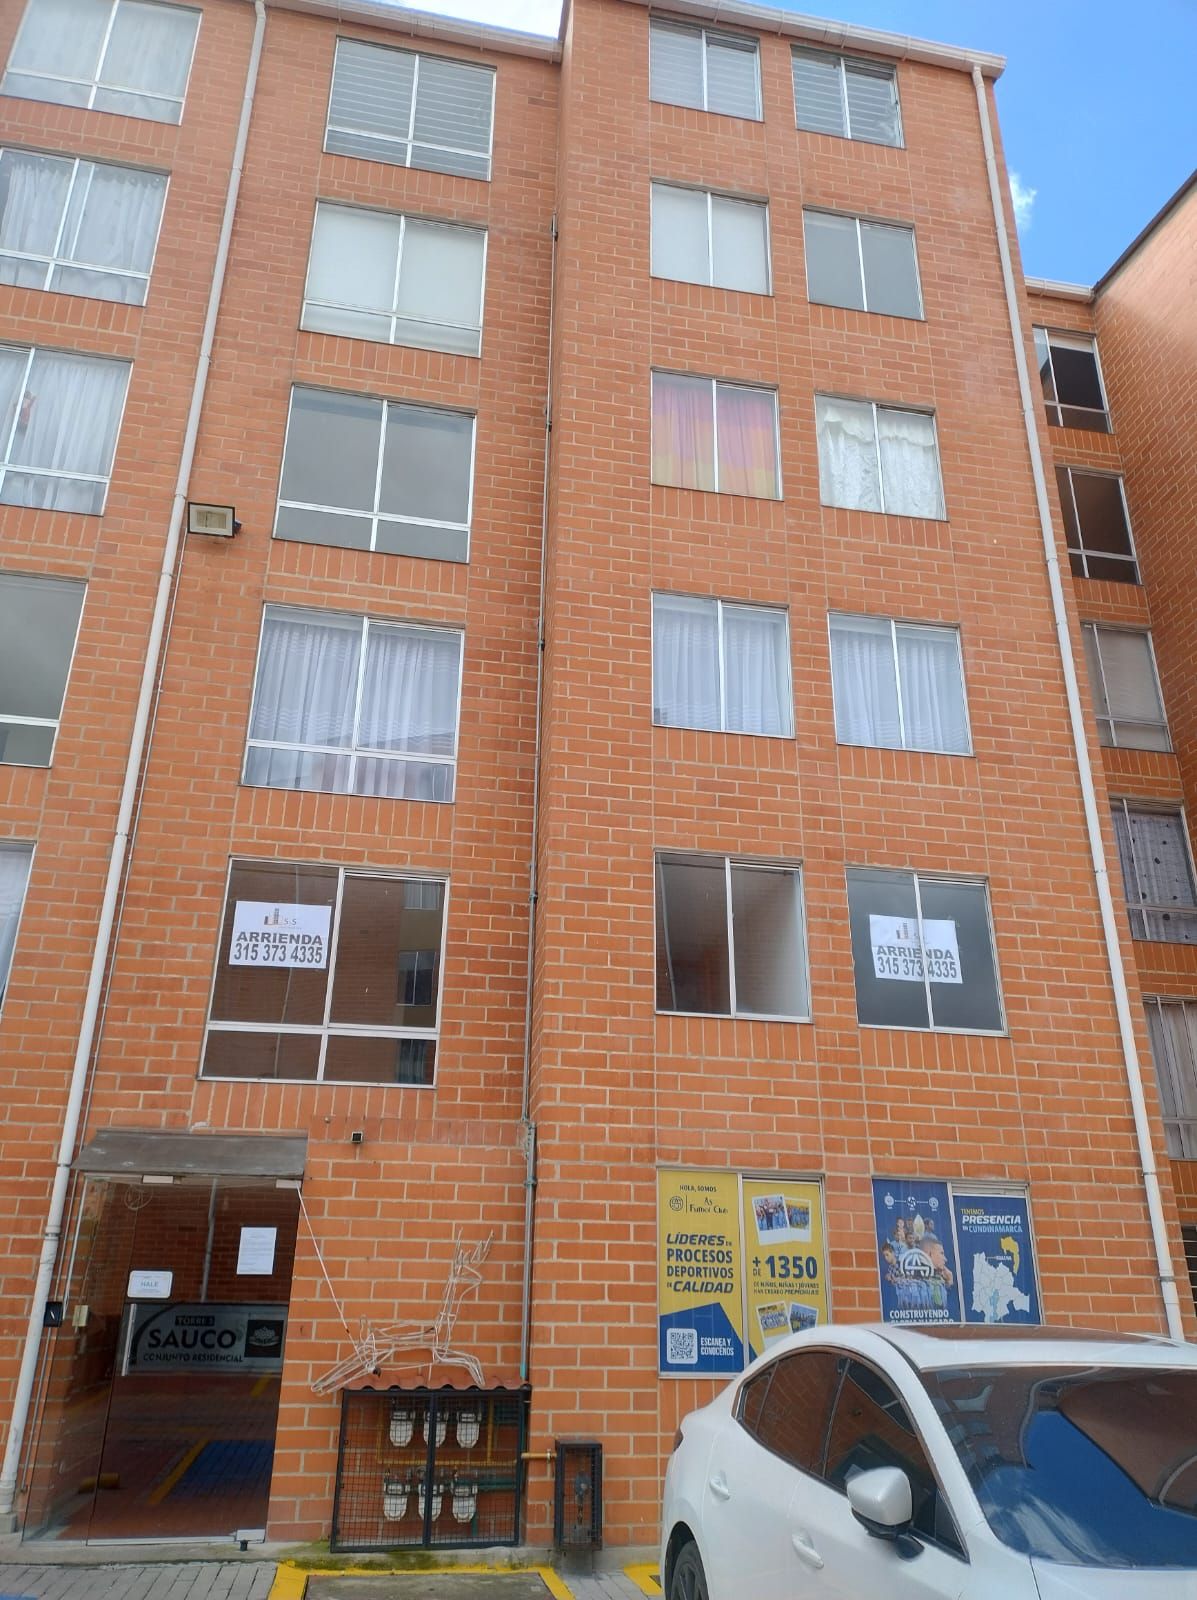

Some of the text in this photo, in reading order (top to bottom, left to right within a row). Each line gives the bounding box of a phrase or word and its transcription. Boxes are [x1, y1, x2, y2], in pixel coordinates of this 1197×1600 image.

[236, 931, 323, 946] ARRIENDA
[234, 943, 323, 964] 315 373 4335
[878, 957, 957, 978] 315 373 4335
[697, 1185, 717, 1193] SOMOS
[962, 1215, 1021, 1225] PRESENCIA
[969, 1225, 1023, 1233] CUNDINAMARCA
[666, 1231, 726, 1247] LÍDERES
[667, 1248, 733, 1263] PROCESOS
[667, 1265, 734, 1279] DEPORTIVOS
[765, 1255, 818, 1279] 1350
[673, 1280, 734, 1294] CALIDAD
[176, 1316, 207, 1325] TORRE
[889, 1309, 950, 1319] CONSTRUYENDO
[148, 1329, 237, 1349] SAUCO
[700, 1337, 732, 1347] ESCANEA Y
[143, 1352, 243, 1363] CONJUNTO RESIDENCIAL
